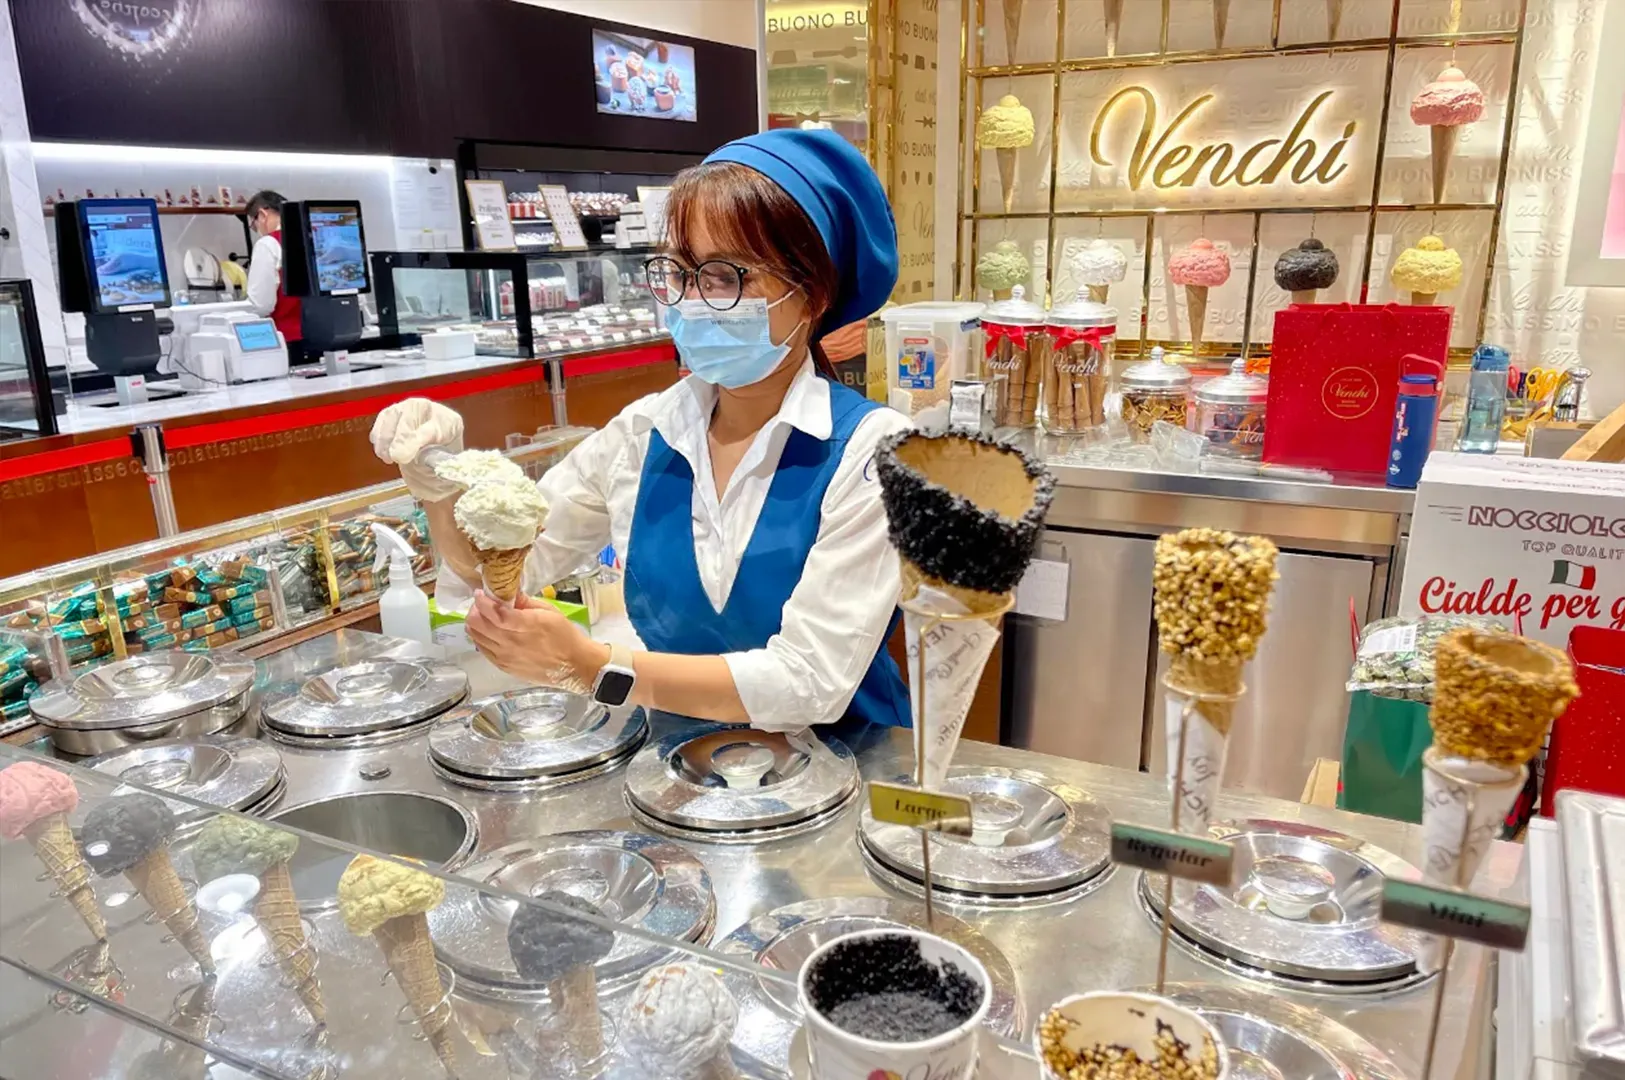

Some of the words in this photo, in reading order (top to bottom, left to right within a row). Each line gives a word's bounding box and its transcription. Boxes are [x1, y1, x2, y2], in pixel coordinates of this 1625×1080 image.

[768, 13, 835, 34] BUONO
[1090, 86, 1356, 191] Venchi
[1330, 382, 1371, 398] Venchi
[1522, 540, 1557, 554] TOP
[1419, 576, 1532, 616] Cialde
[1540, 593, 1601, 630] per
[1127, 837, 1214, 868] Regular
